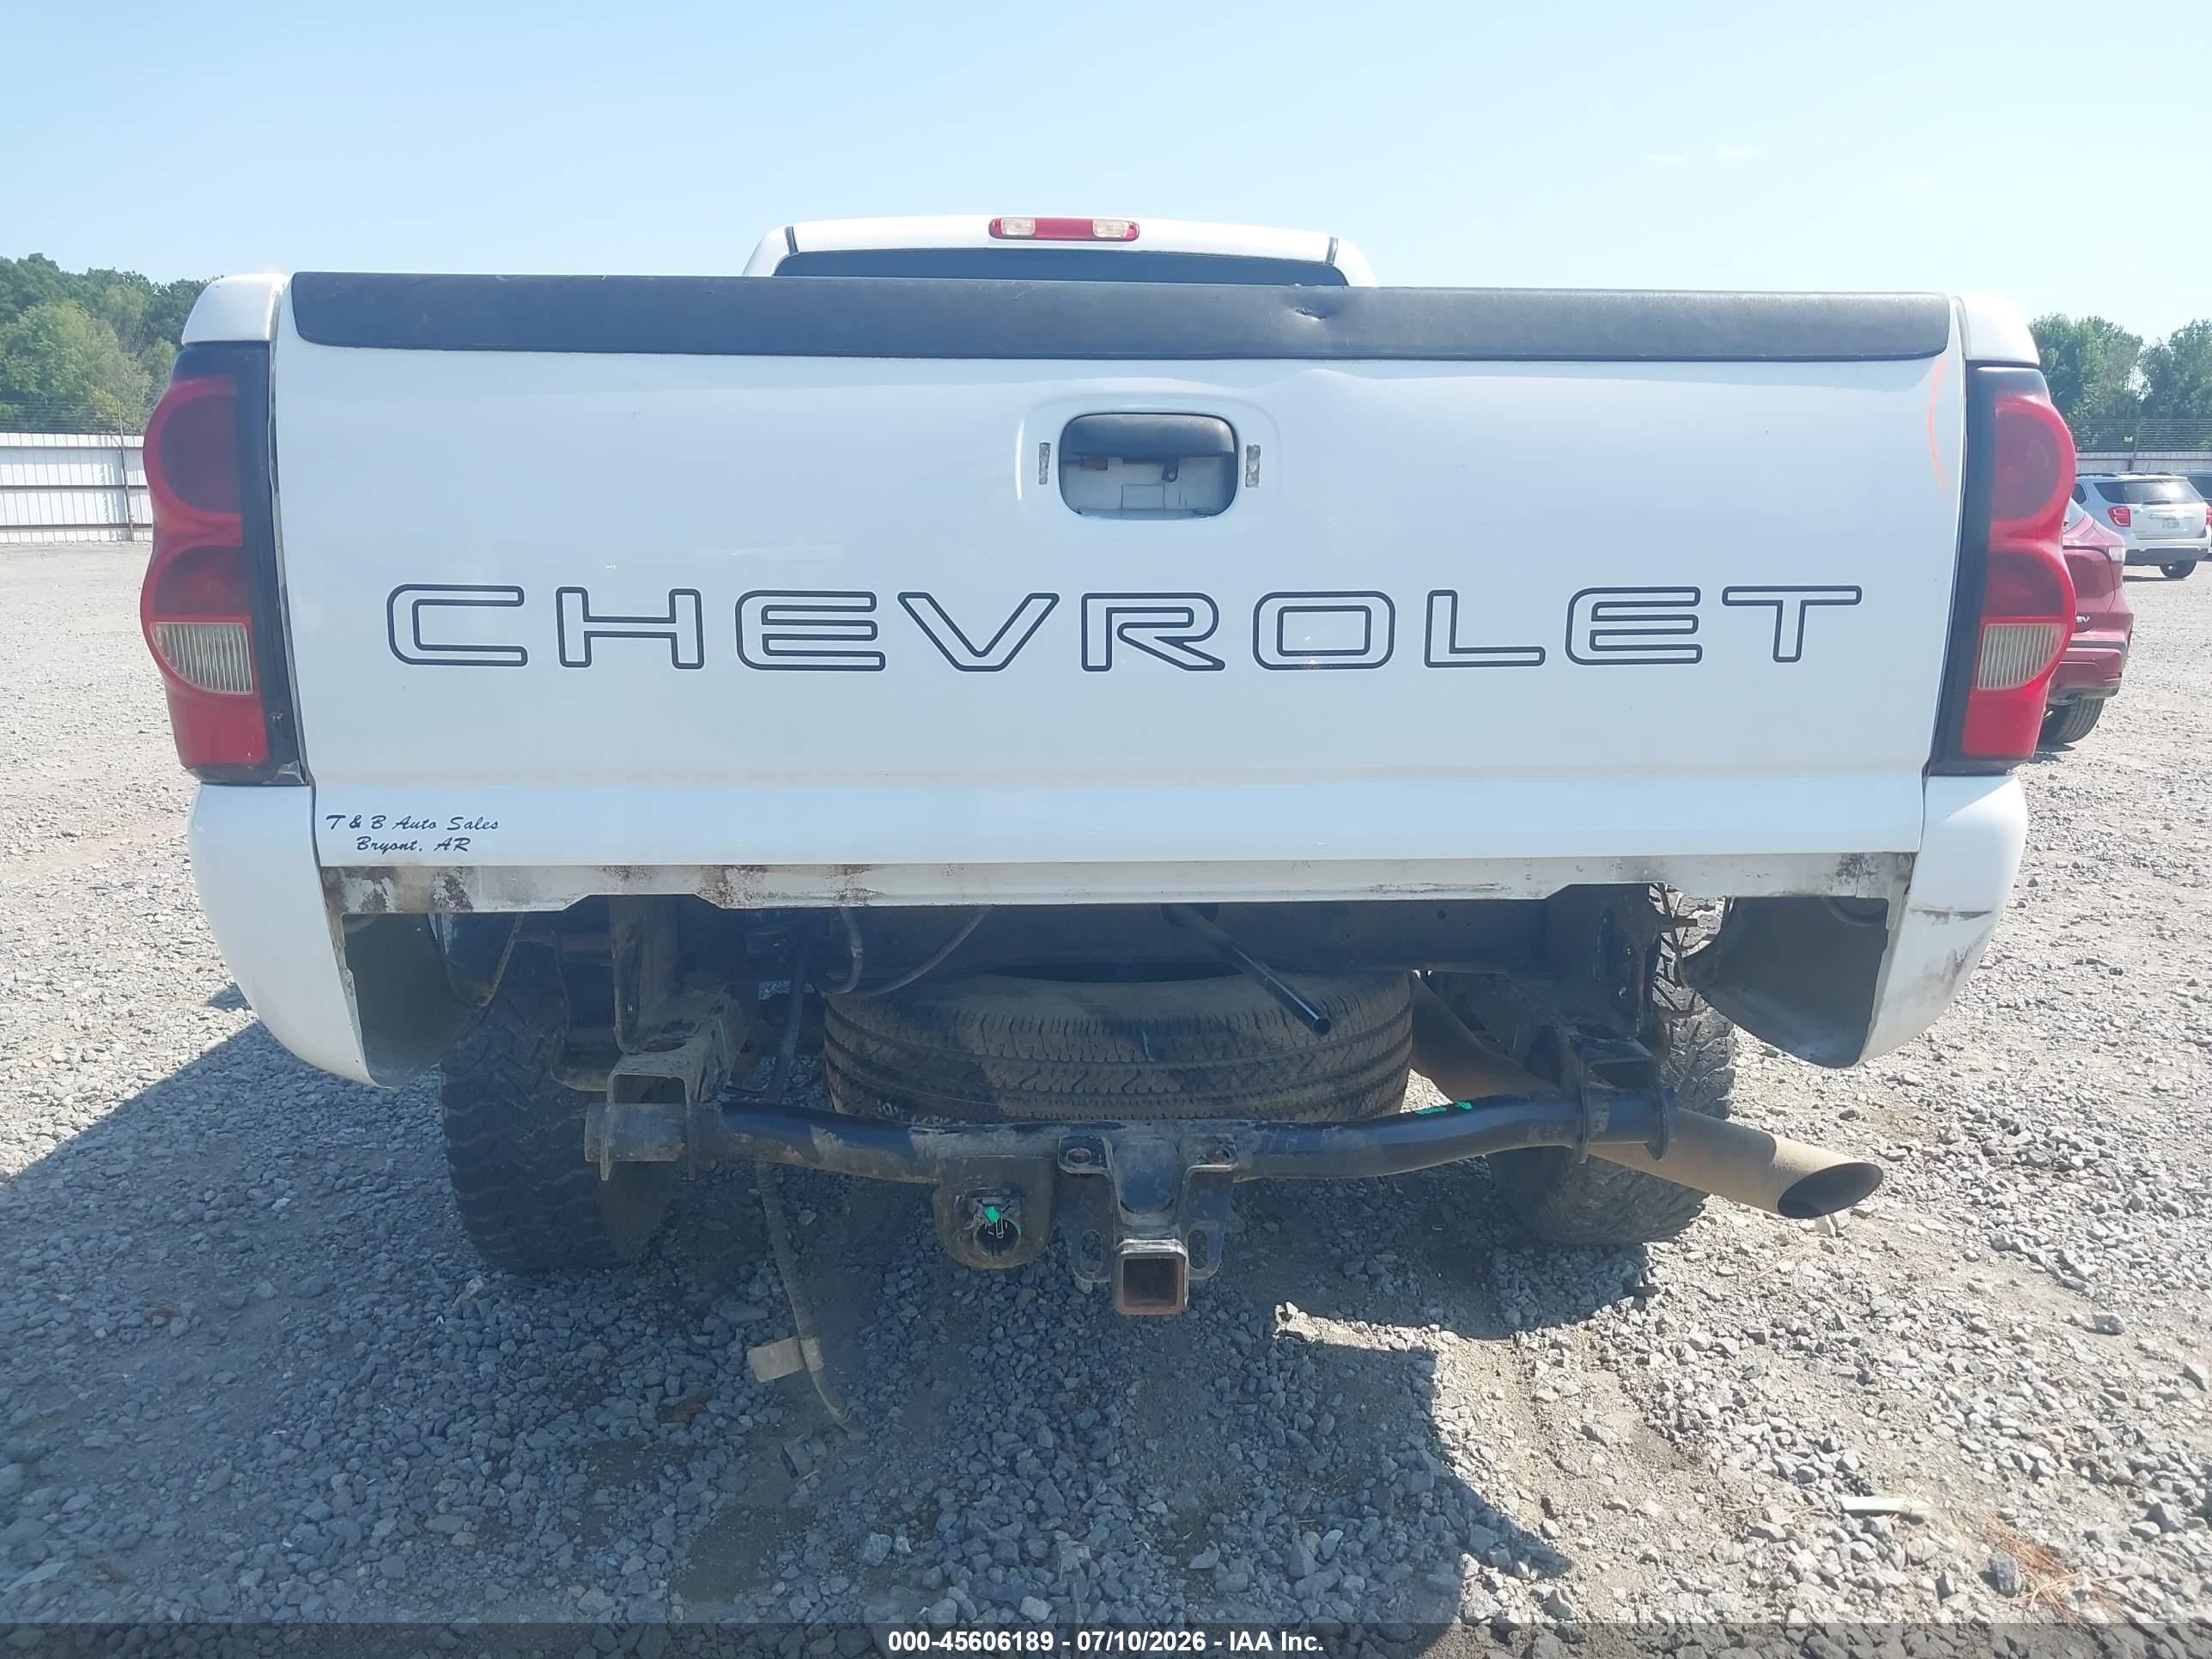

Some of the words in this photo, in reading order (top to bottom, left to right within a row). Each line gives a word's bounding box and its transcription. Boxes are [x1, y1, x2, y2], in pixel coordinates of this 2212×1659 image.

[386, 584, 1863, 672] CHEVROLET
[325, 814, 346, 830] T
[349, 814, 362, 830] &
[371, 815, 386, 830] B
[392, 815, 437, 830] Auto
[447, 816, 500, 831] Sales
[433, 836, 471, 853] AR
